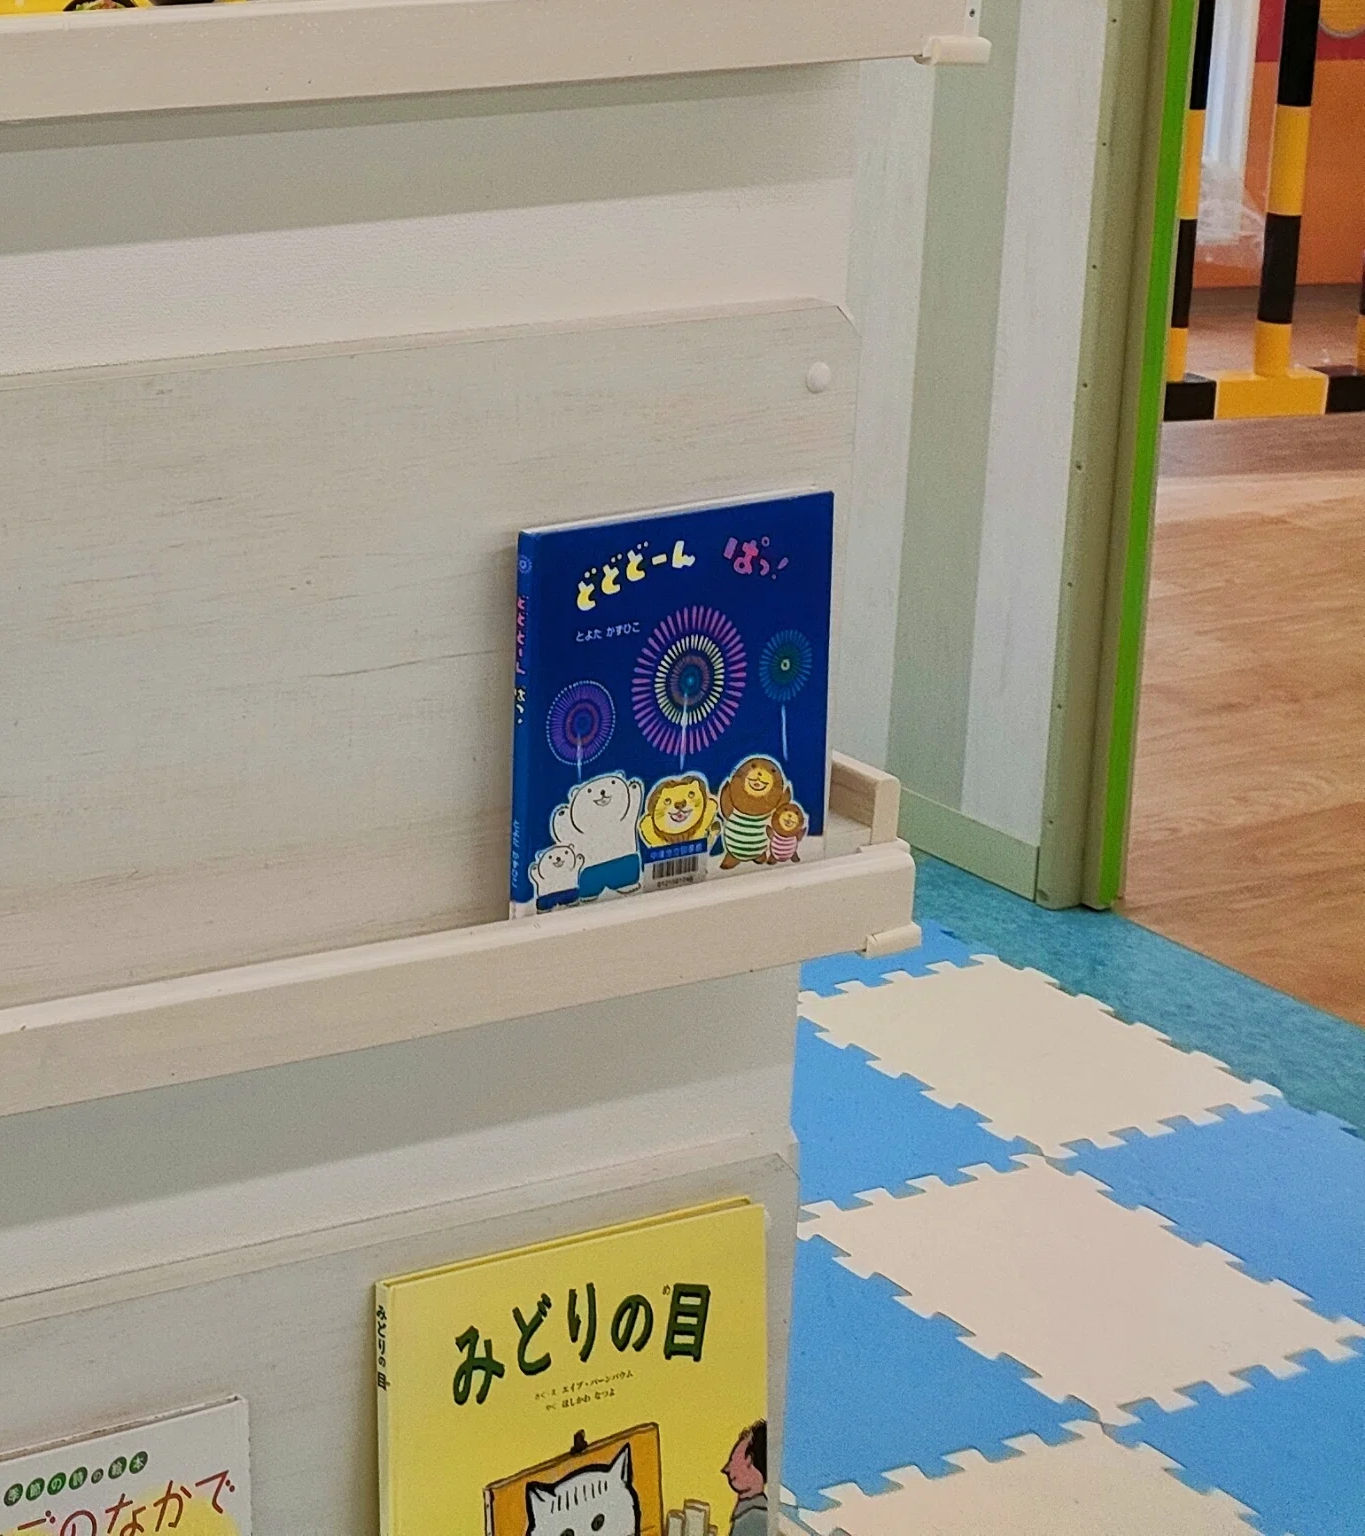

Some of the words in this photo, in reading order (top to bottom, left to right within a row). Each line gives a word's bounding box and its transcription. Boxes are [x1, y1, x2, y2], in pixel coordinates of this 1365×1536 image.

[575, 539, 697, 612] どどどーん
[575, 629, 603, 643] とよた
[605, 621, 642, 638] かずひこ
[452, 1281, 712, 1407] みどりの目
